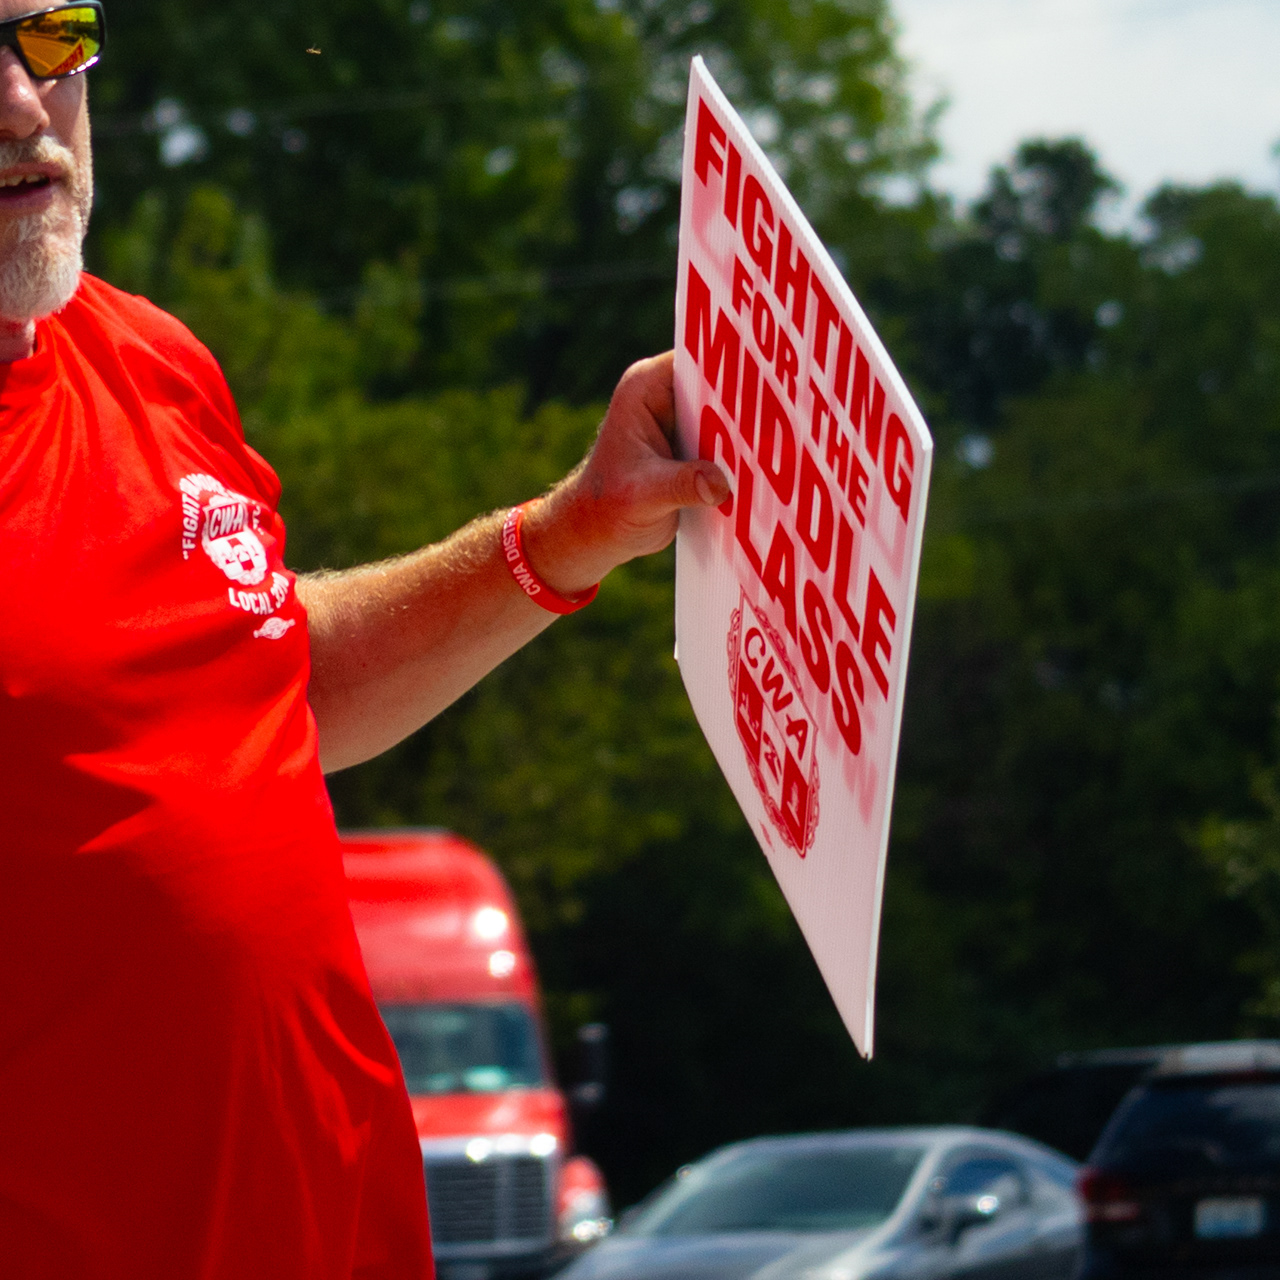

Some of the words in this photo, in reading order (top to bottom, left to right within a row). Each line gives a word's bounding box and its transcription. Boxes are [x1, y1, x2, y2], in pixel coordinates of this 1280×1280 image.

[694, 95, 914, 526] FIGHTING
[732, 253, 799, 408] FOR
[809, 375, 870, 529] THE
[209, 505, 244, 539] CWA
[513, 562, 540, 596] CWA
[685, 259, 896, 703] MIDDLE
[699, 404, 865, 756] CLASS
[228, 587, 274, 615] LOCAL
[744, 627, 808, 760] CWA
